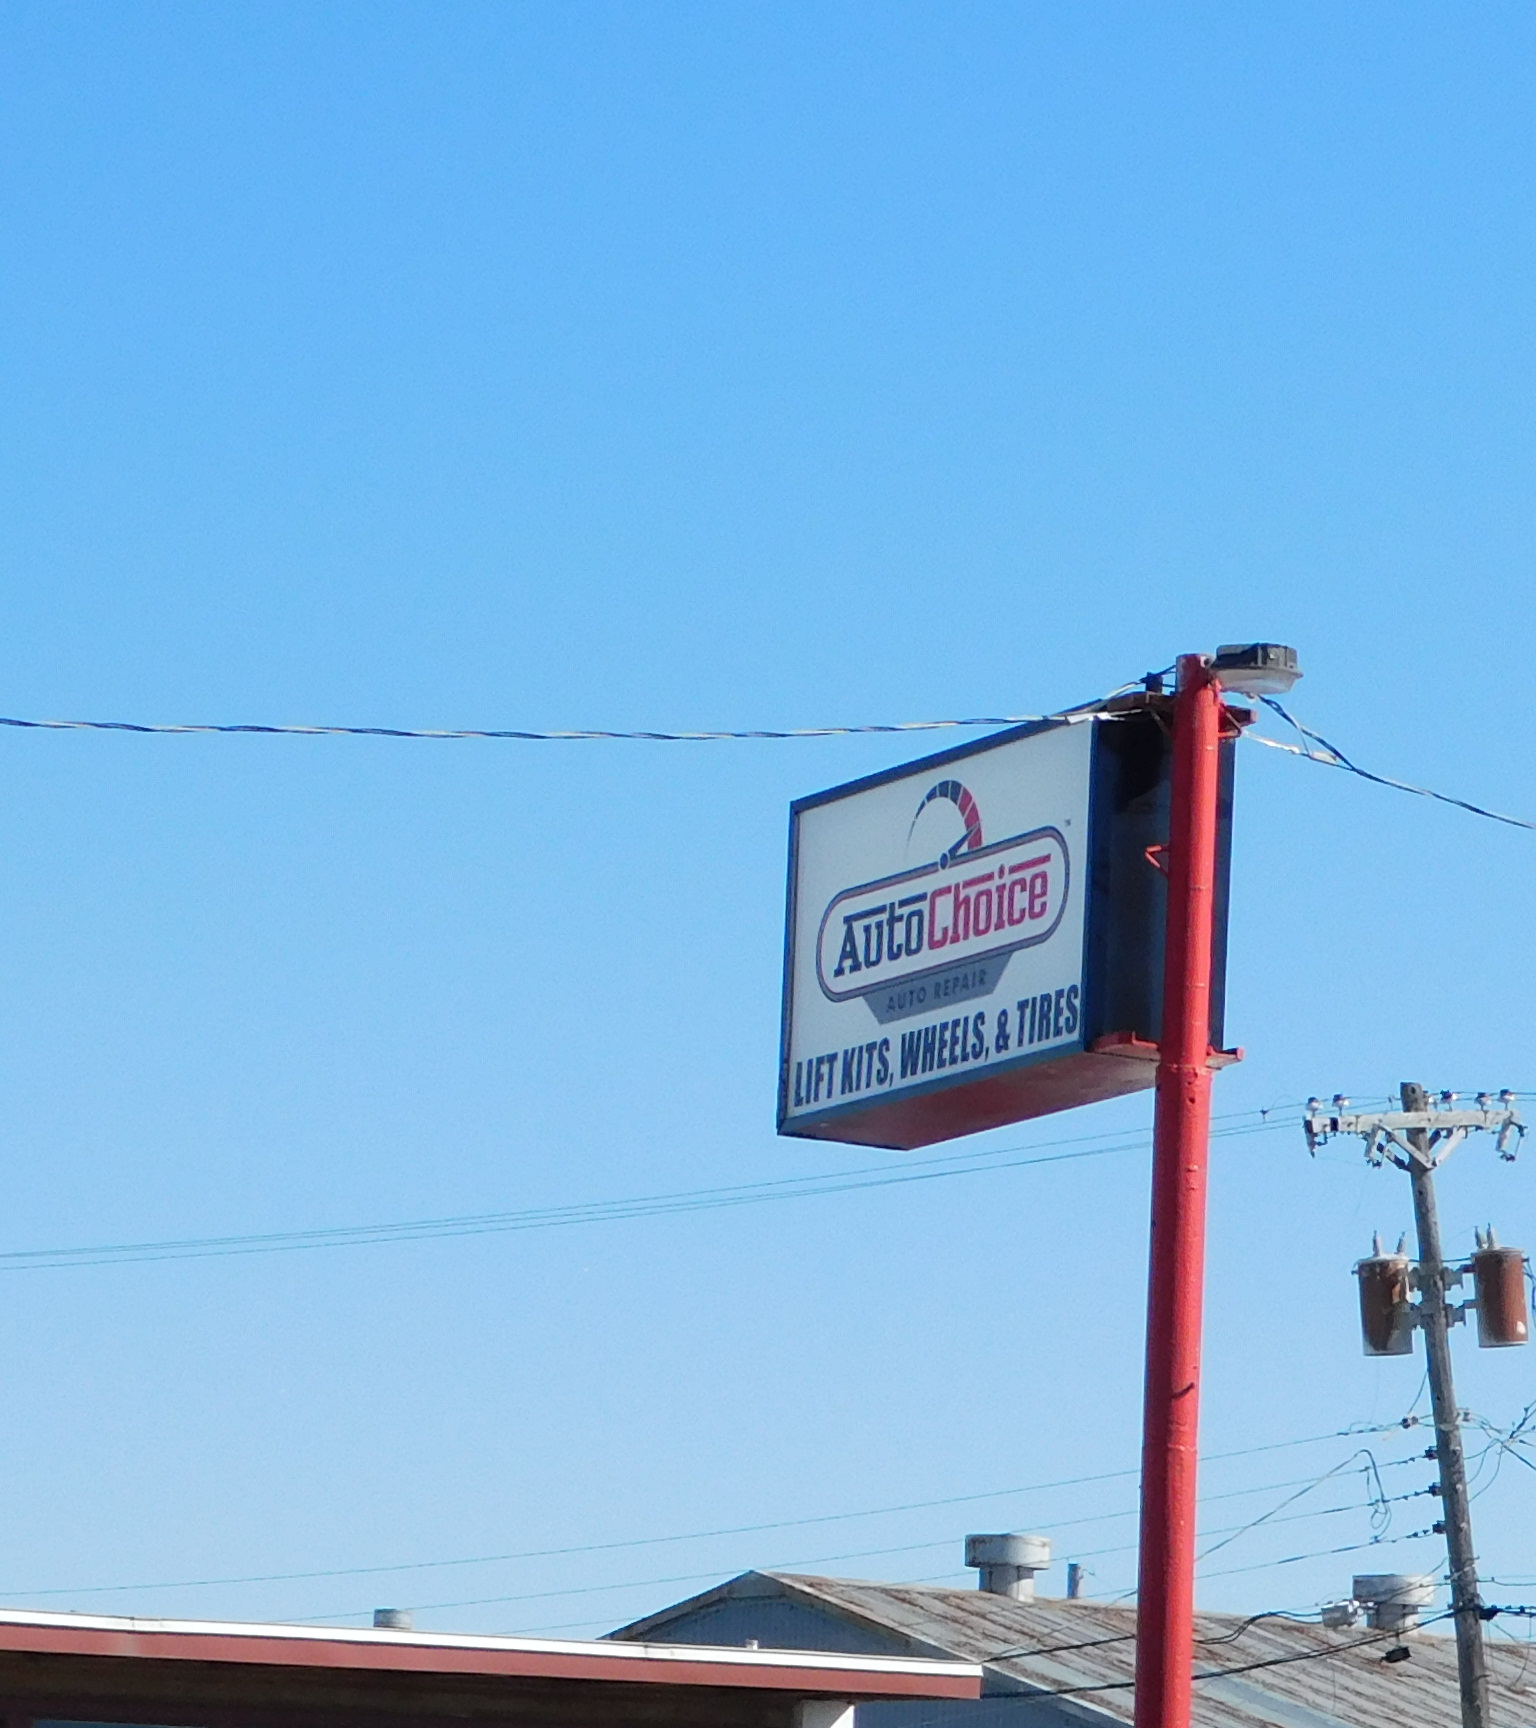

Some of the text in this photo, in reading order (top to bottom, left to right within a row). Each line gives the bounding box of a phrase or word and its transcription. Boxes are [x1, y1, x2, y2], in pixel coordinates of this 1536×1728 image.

[833, 854, 1052, 978] AutoChoice
[794, 983, 1079, 1107] LIFT KITS, WHEELS, & TIRES
[886, 969, 987, 1014] AUTO REPAIR
